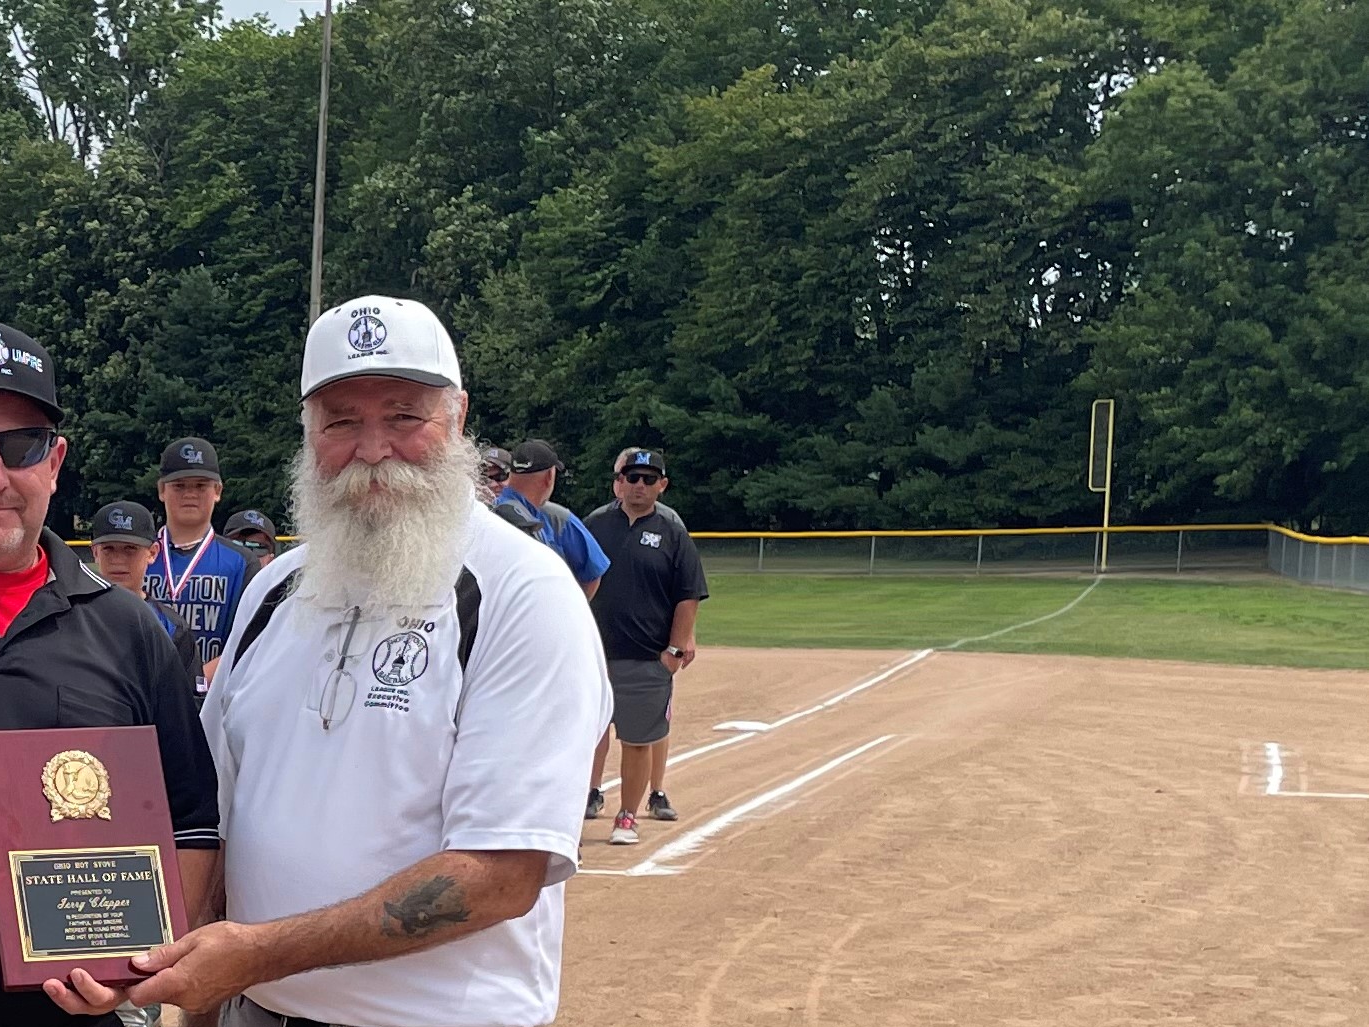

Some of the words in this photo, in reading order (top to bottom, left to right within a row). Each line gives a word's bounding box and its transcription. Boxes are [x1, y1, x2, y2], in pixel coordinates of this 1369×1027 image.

[351, 307, 380, 318] OHIO
[396, 616, 435, 633] OHIO
[53, 862, 71, 870] OHIO
[74, 861, 89, 869] HOT
[25, 874, 64, 885] STATE
[67, 873, 99, 883] HALL
[102, 872, 117, 882] OF
[120, 870, 153, 880] FAME
